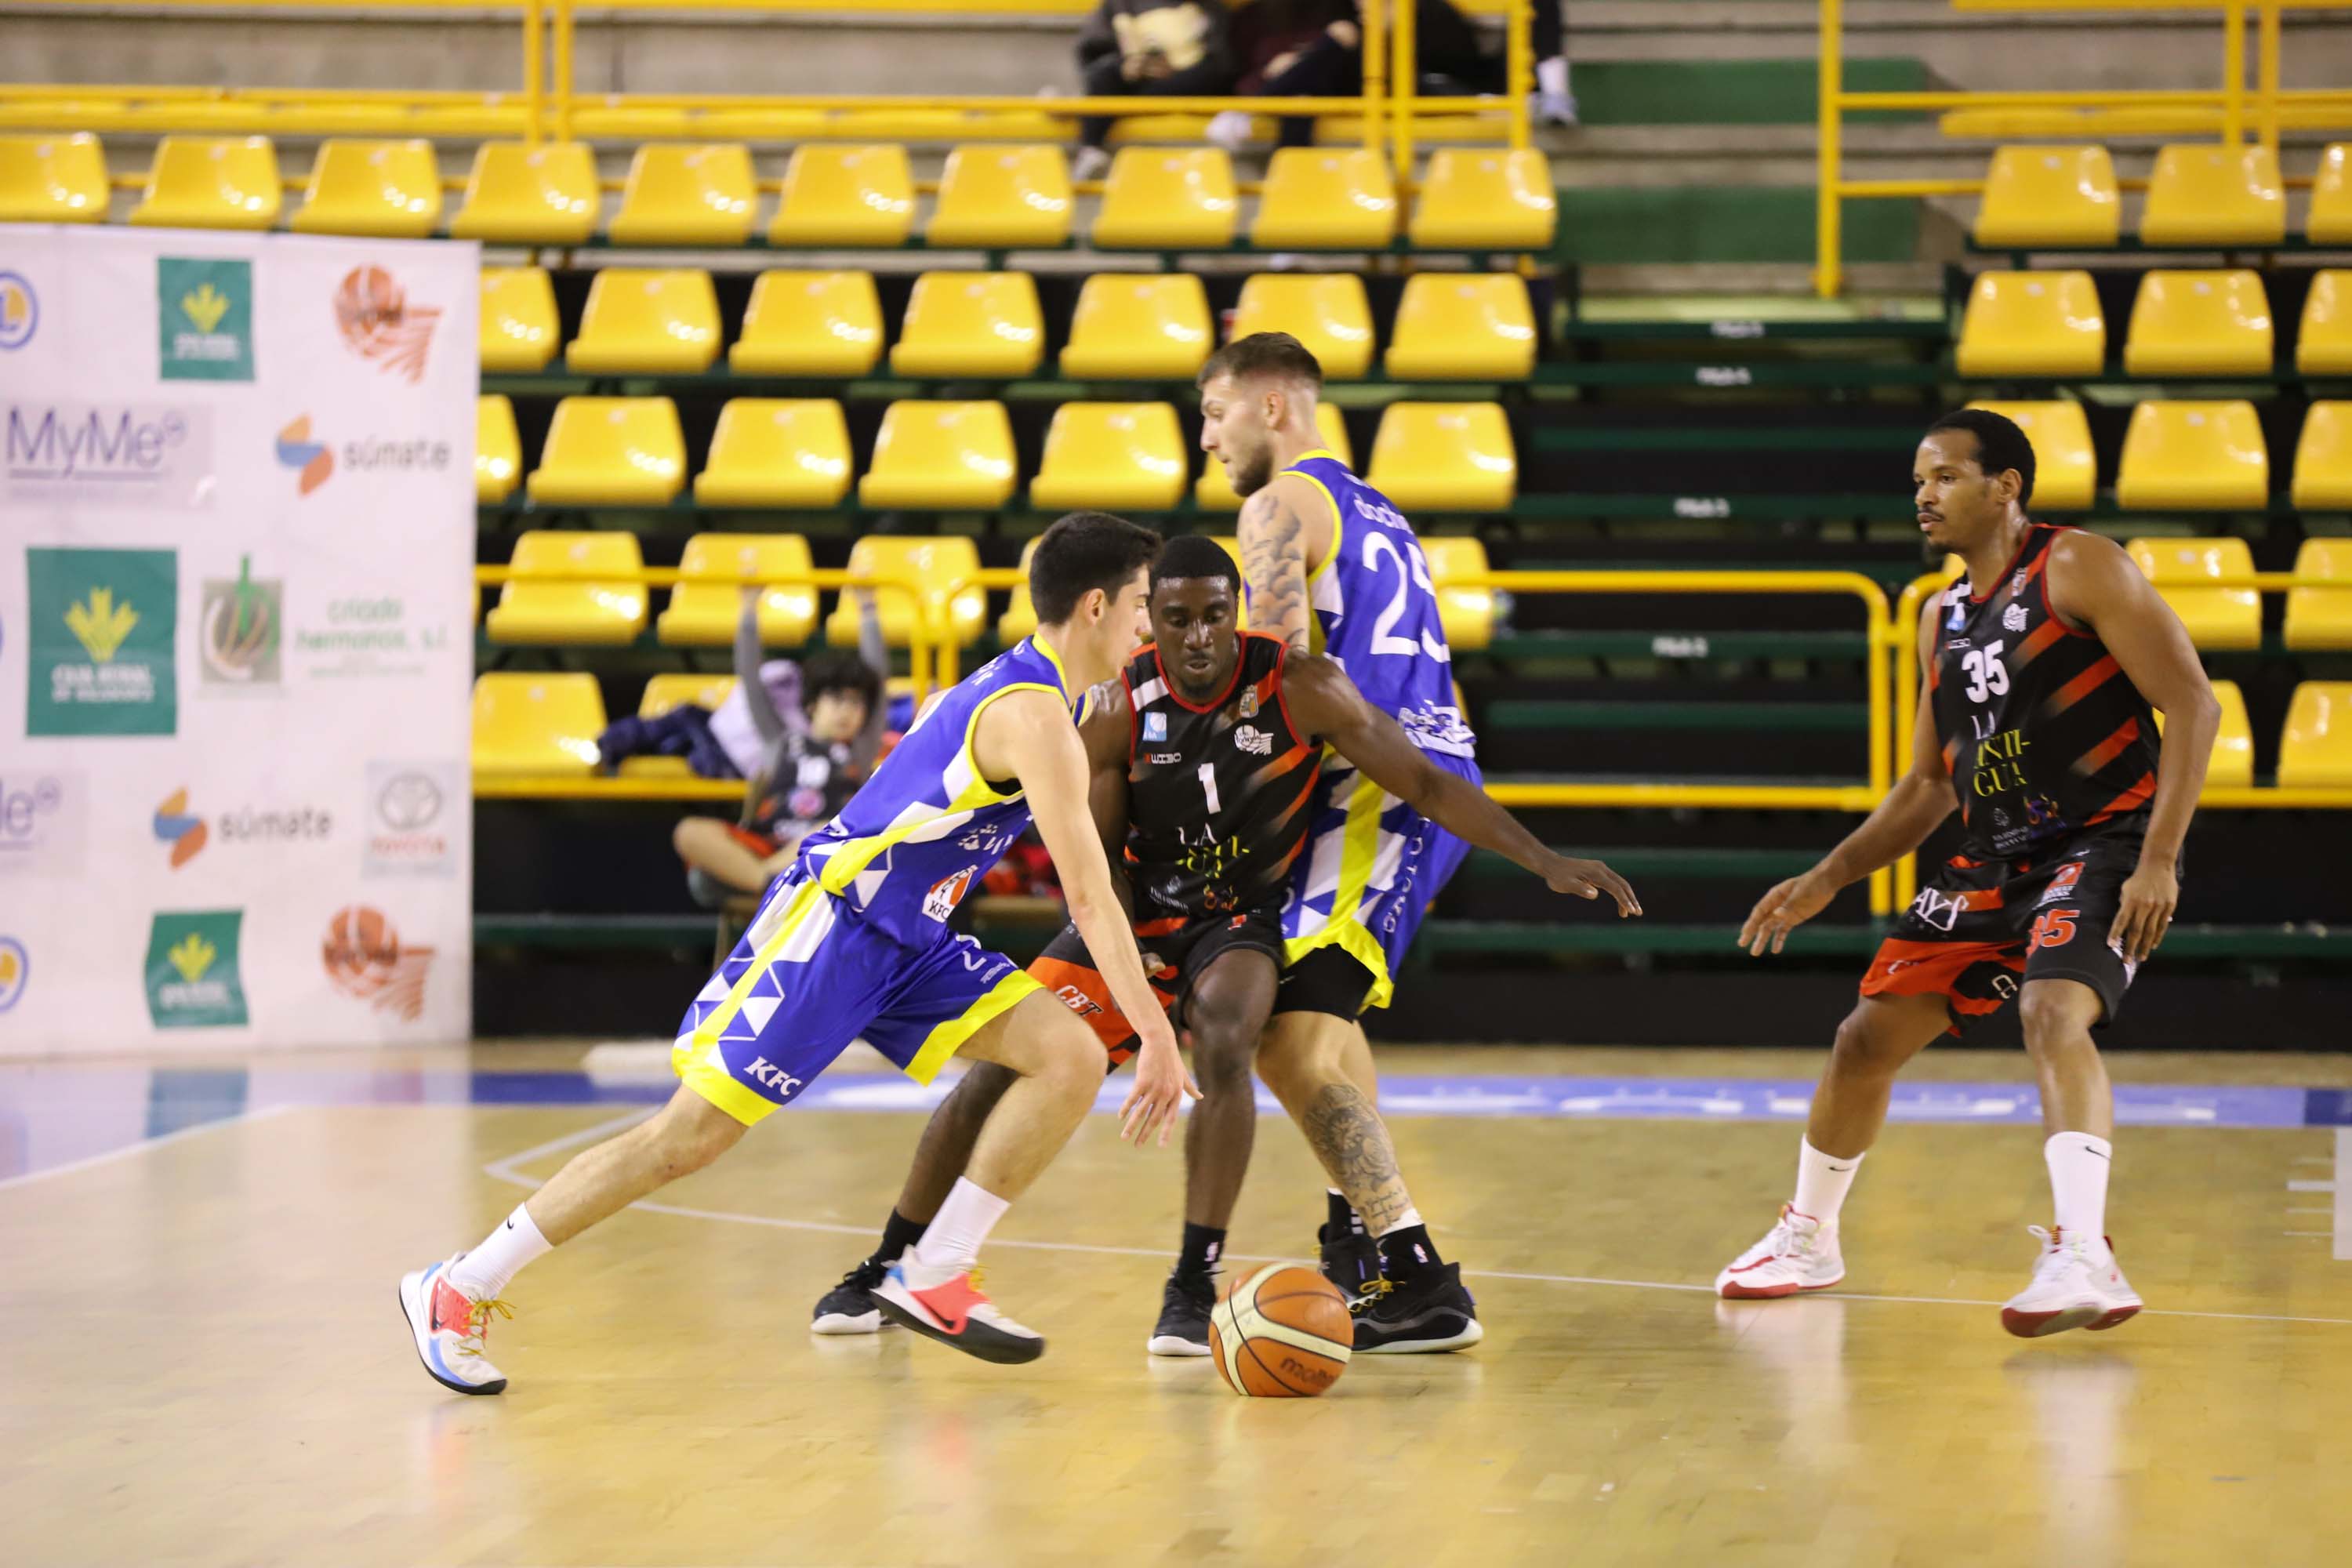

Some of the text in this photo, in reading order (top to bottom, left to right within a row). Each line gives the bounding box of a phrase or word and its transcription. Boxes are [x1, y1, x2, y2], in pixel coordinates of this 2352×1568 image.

[1363, 531, 1451, 664] 25
[1962, 639, 2010, 704] 35
[1197, 762, 1221, 815] 1
[928, 900, 950, 920] KFC
[1055, 984, 1105, 1017] CBT
[743, 1056, 801, 1097] KFC
